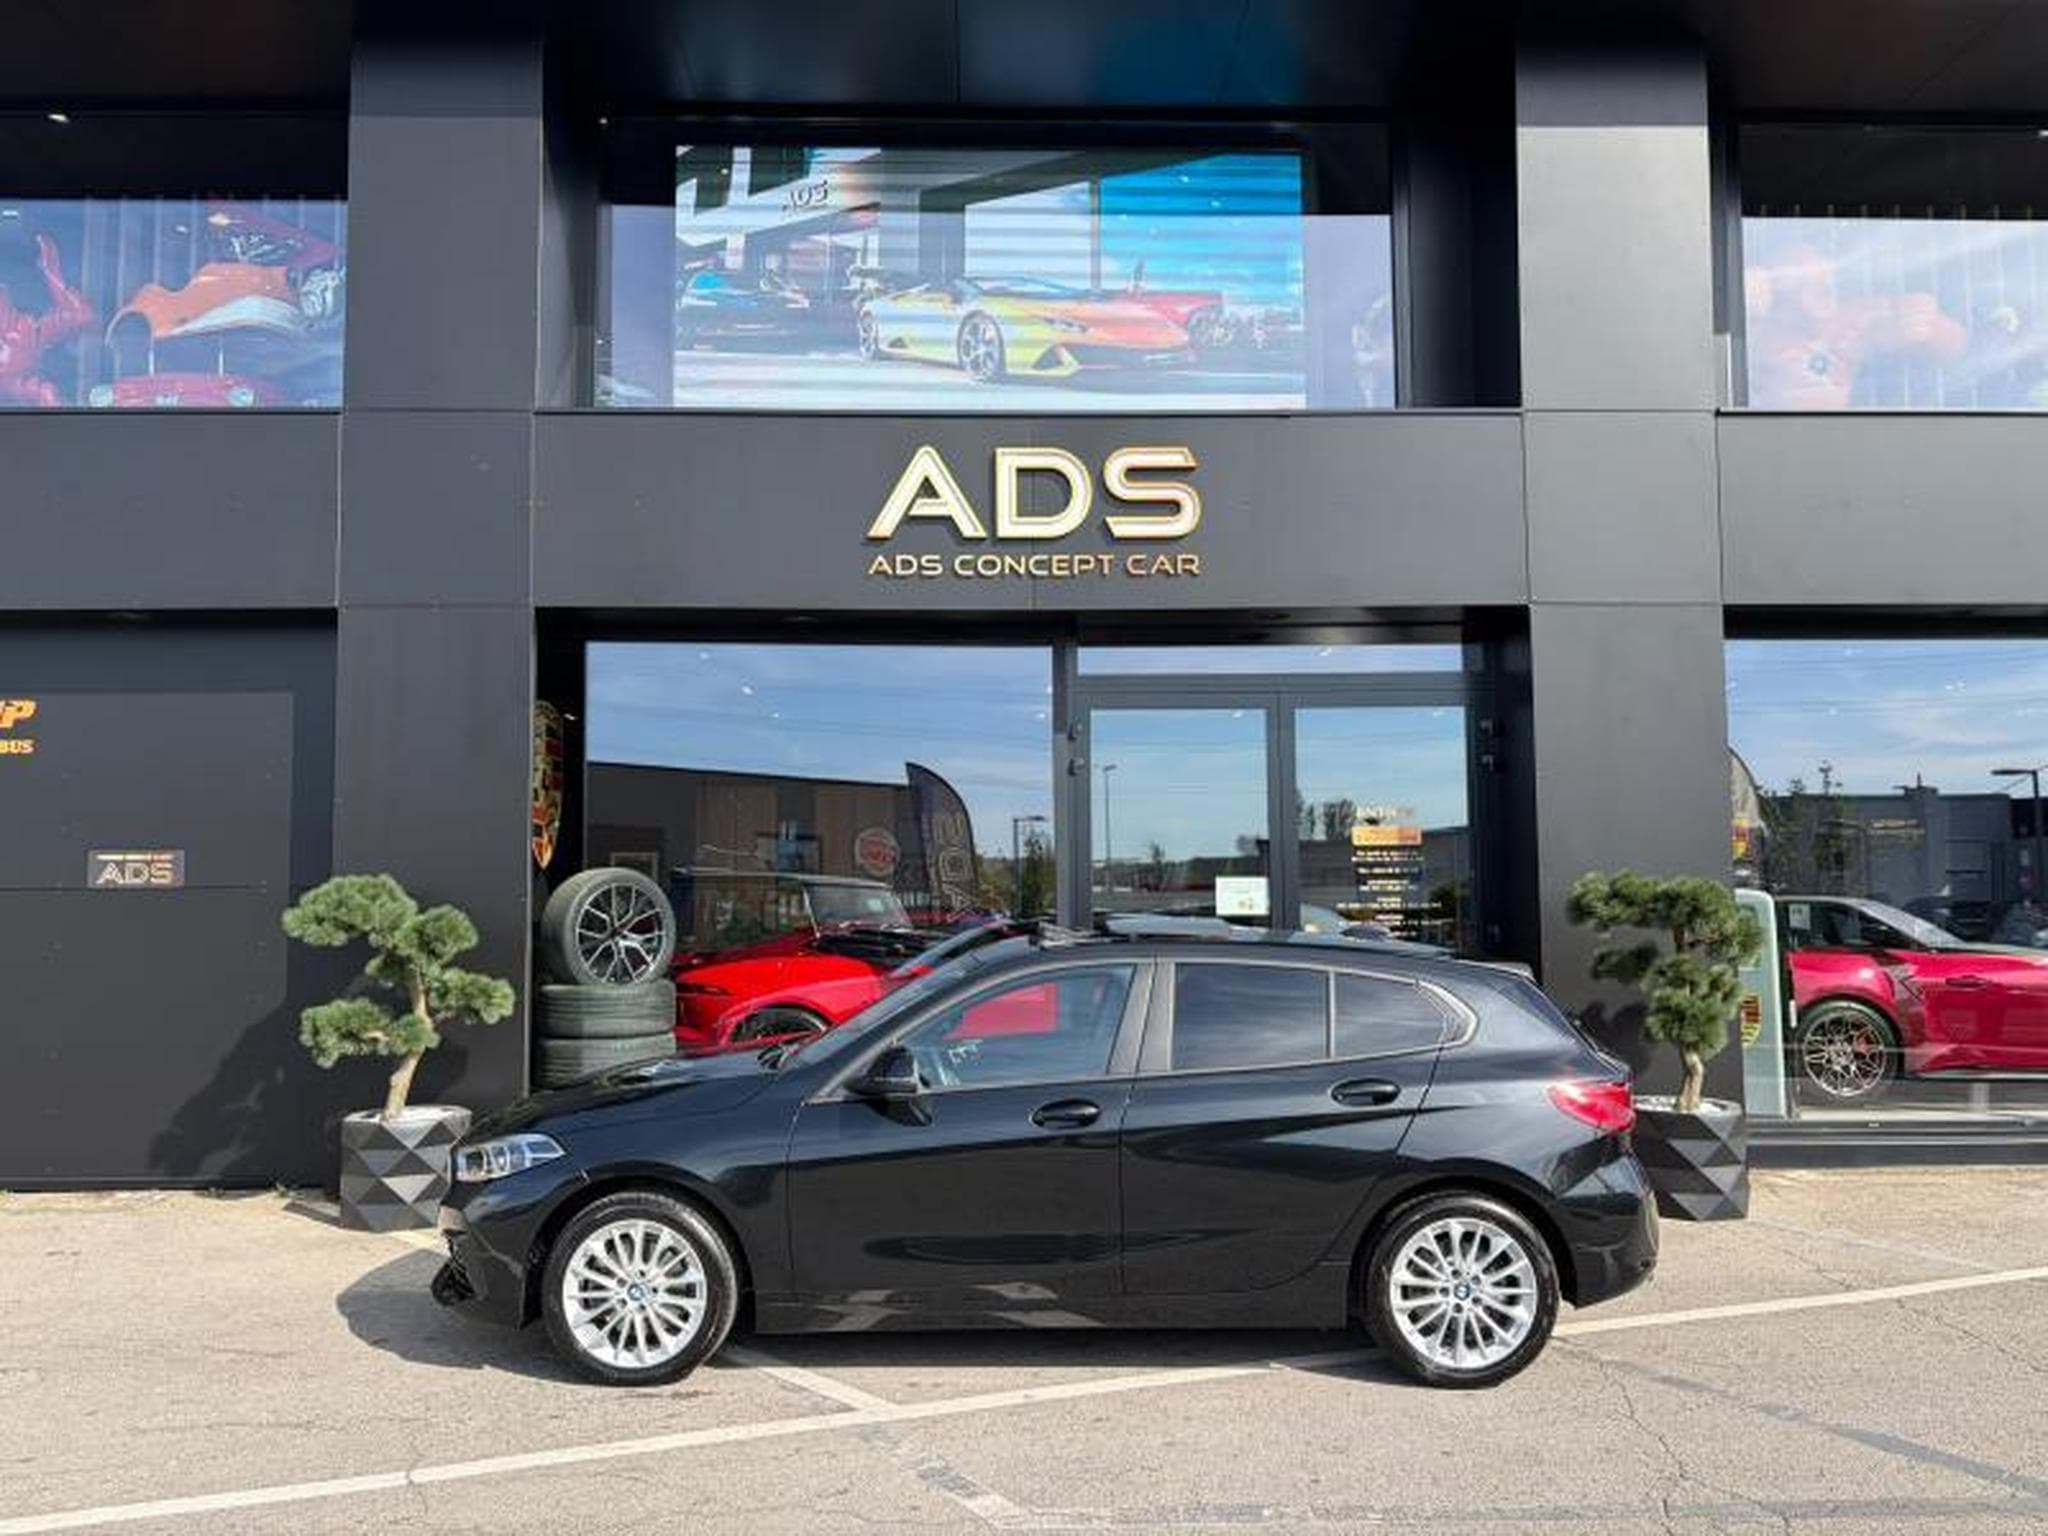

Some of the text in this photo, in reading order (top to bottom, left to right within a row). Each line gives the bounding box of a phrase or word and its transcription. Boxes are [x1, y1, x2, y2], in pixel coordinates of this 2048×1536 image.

[866, 445, 1201, 539] ADS
[868, 554, 1200, 576] ADS CONCEPT CAR
[96, 861, 172, 884] ADS
